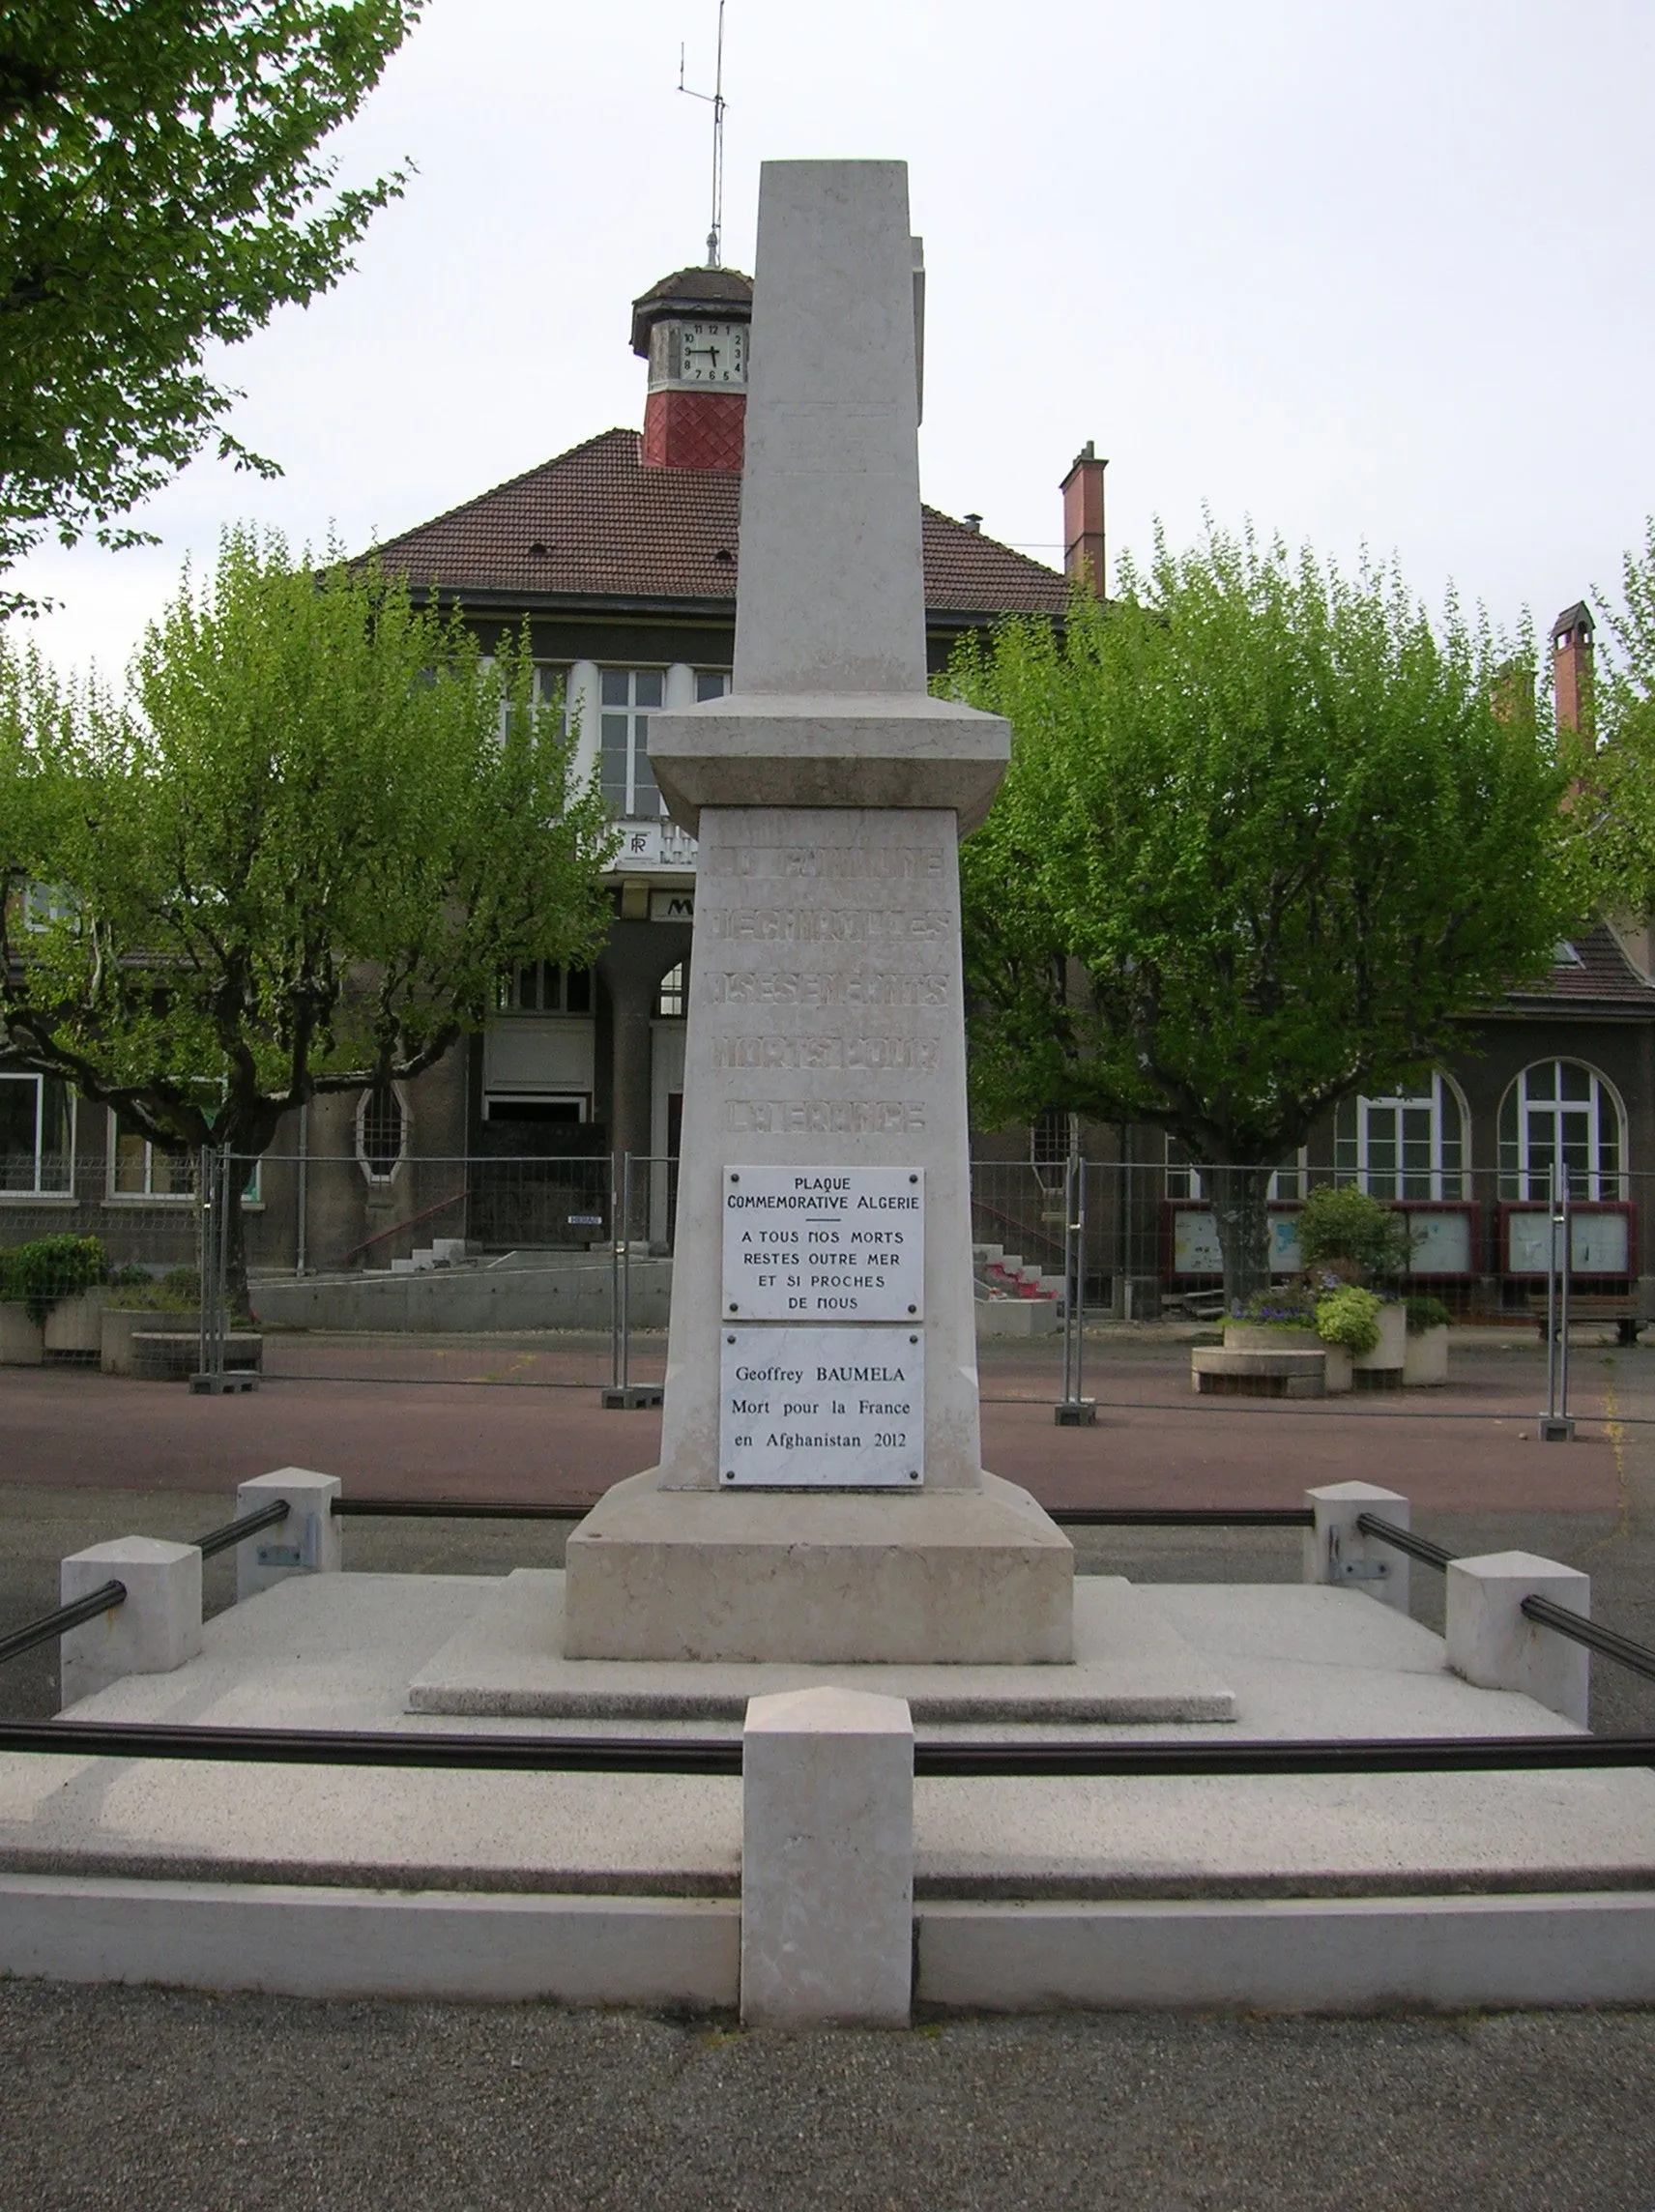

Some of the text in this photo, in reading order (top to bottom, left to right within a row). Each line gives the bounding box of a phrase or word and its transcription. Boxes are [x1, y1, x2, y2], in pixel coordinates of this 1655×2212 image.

[694, 324, 703, 335] 11
[709, 325, 718, 335] 12
[725, 325, 731, 335] 1
[684, 334, 694, 343] 10
[735, 335, 741, 345] 2
[684, 347, 691, 357] 9
[735, 349, 741, 359] 3
[684, 361, 691, 370] 8
[735, 363, 740, 372] 4
[695, 369, 702, 379] 7
[709, 370, 716, 380] 6
[723, 371, 730, 381] 5
[729, 972, 799, 1005] SES
[711, 1036, 941, 1070] MORTS POUR
[724, 1100, 926, 1134] LA FRANCE
[795, 1178, 851, 1193] PLAQUE
[727, 1195, 919, 1209] COMMEMORATIVE ALGERIE
[741, 1232, 904, 1243] A TOUS NOS MORTS
[743, 1253, 901, 1266] RESTES OUTRE MER
[758, 1275, 886, 1288] ET SI PROCHES
[788, 1297, 858, 1309] DE NOUS
[736, 1366, 906, 1383] Geoffrey BAUMELA
[732, 1399, 911, 1416] Mort pour la France
[735, 1433, 907, 1449] en Afghanistan 2012
